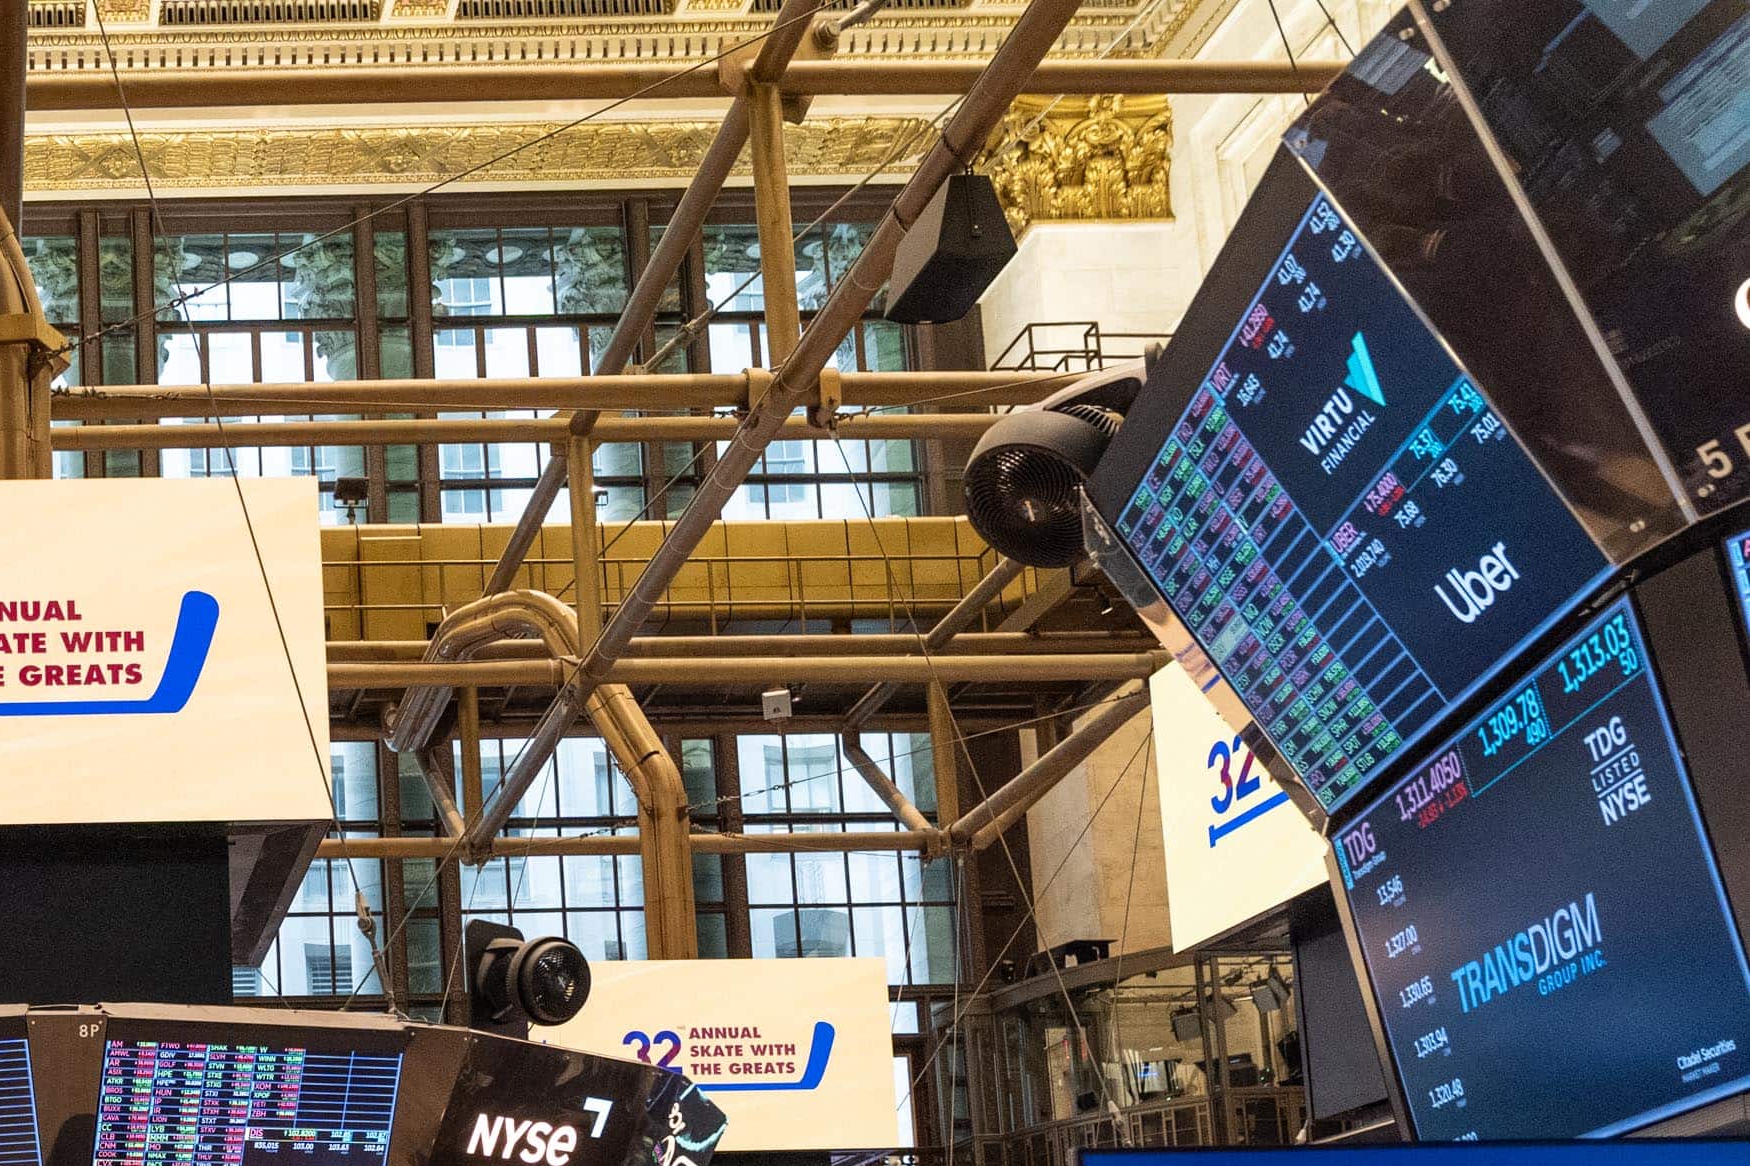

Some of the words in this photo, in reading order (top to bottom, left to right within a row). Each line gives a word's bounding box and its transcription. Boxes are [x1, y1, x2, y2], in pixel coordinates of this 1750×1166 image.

[1300, 387, 1354, 456] VIRTU
[1320, 410, 1376, 475] FINANCIAL
[1329, 521, 1359, 554] UBER
[1434, 541, 1521, 624] Uber
[61, 631, 145, 654] WITH
[1558, 614, 1630, 694] 1,313.03
[19, 663, 144, 687] GREATS
[1477, 689, 1540, 757] 1,309.78
[1583, 716, 1627, 762] TDG
[1395, 751, 1462, 822] 1,311.4050
[1591, 751, 1640, 792] LISTED
[1597, 774, 1651, 826] NYSE
[1344, 822, 1376, 867] TDG
[1451, 892, 1603, 1014] TRANSDIGM
[1537, 964, 1578, 997] GROUP
[79, 1024, 100, 1038] 8P
[689, 1026, 762, 1040] ANNUAL
[690, 1044, 744, 1058] SKATE
[750, 1043, 796, 1057] WITH
[690, 1063, 723, 1076] THE
[729, 1062, 796, 1075] GREATS
[1676, 1050, 1702, 1071] Citadel
[1699, 1039, 1737, 1063] Securities
